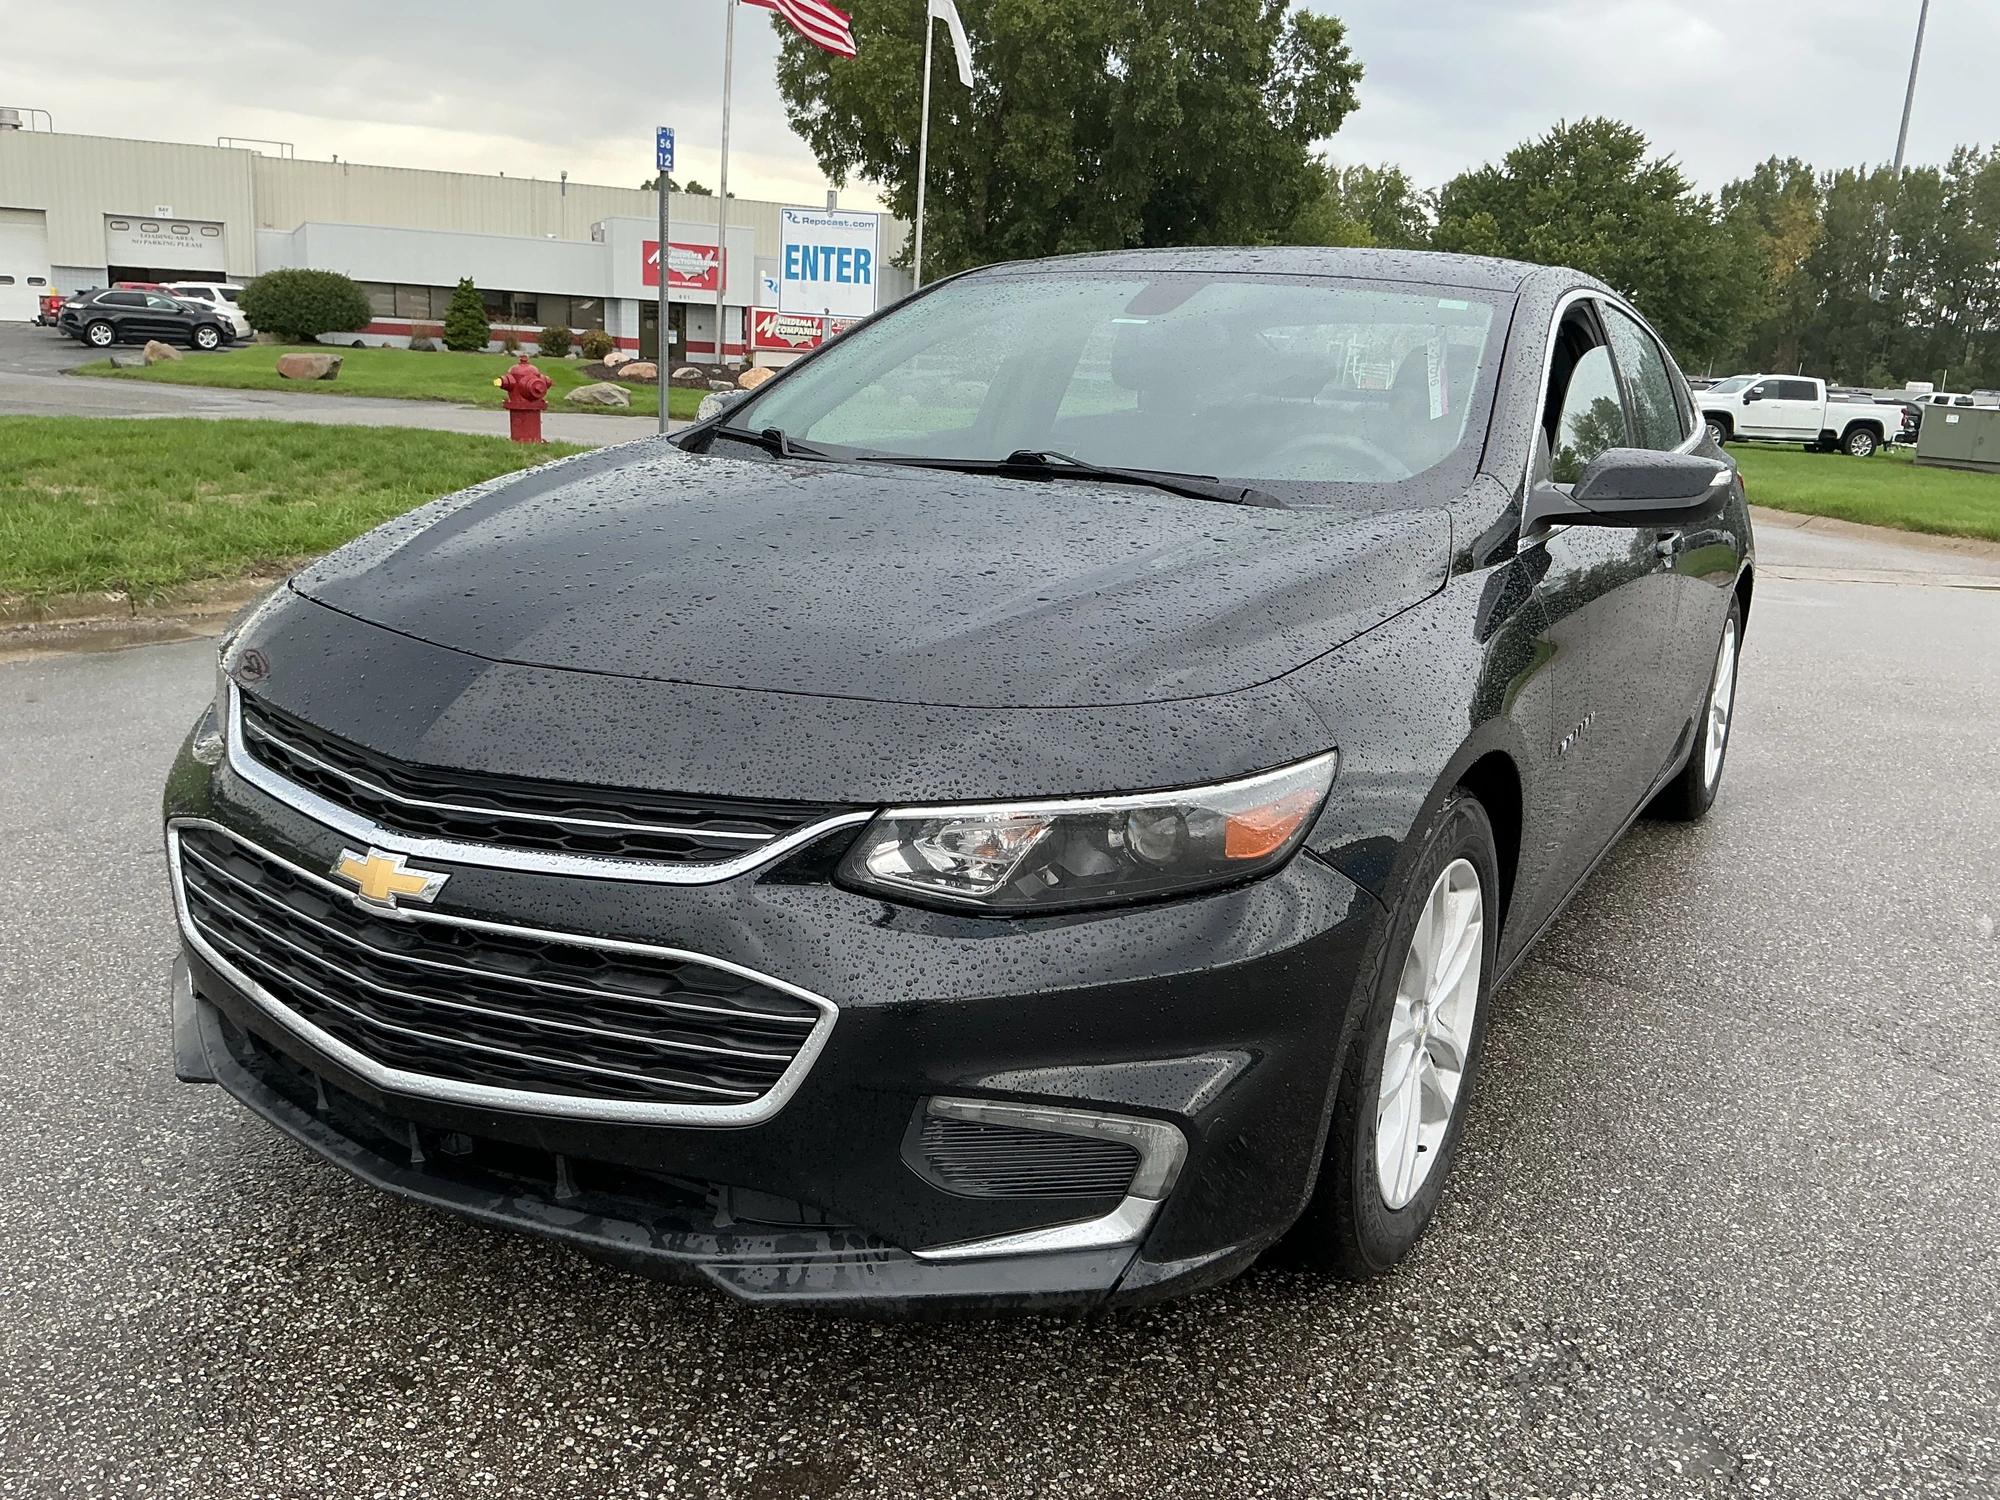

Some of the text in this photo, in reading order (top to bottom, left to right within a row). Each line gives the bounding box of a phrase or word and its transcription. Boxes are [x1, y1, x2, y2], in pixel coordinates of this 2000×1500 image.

[660, 138, 671, 149] 56
[658, 152, 672, 167] 12
[802, 217, 874, 228] Repocast.com
[785, 244, 872, 285] ENTER
[779, 317, 813, 328] MIEDEMA
[775, 326, 822, 337] COMPANIES
